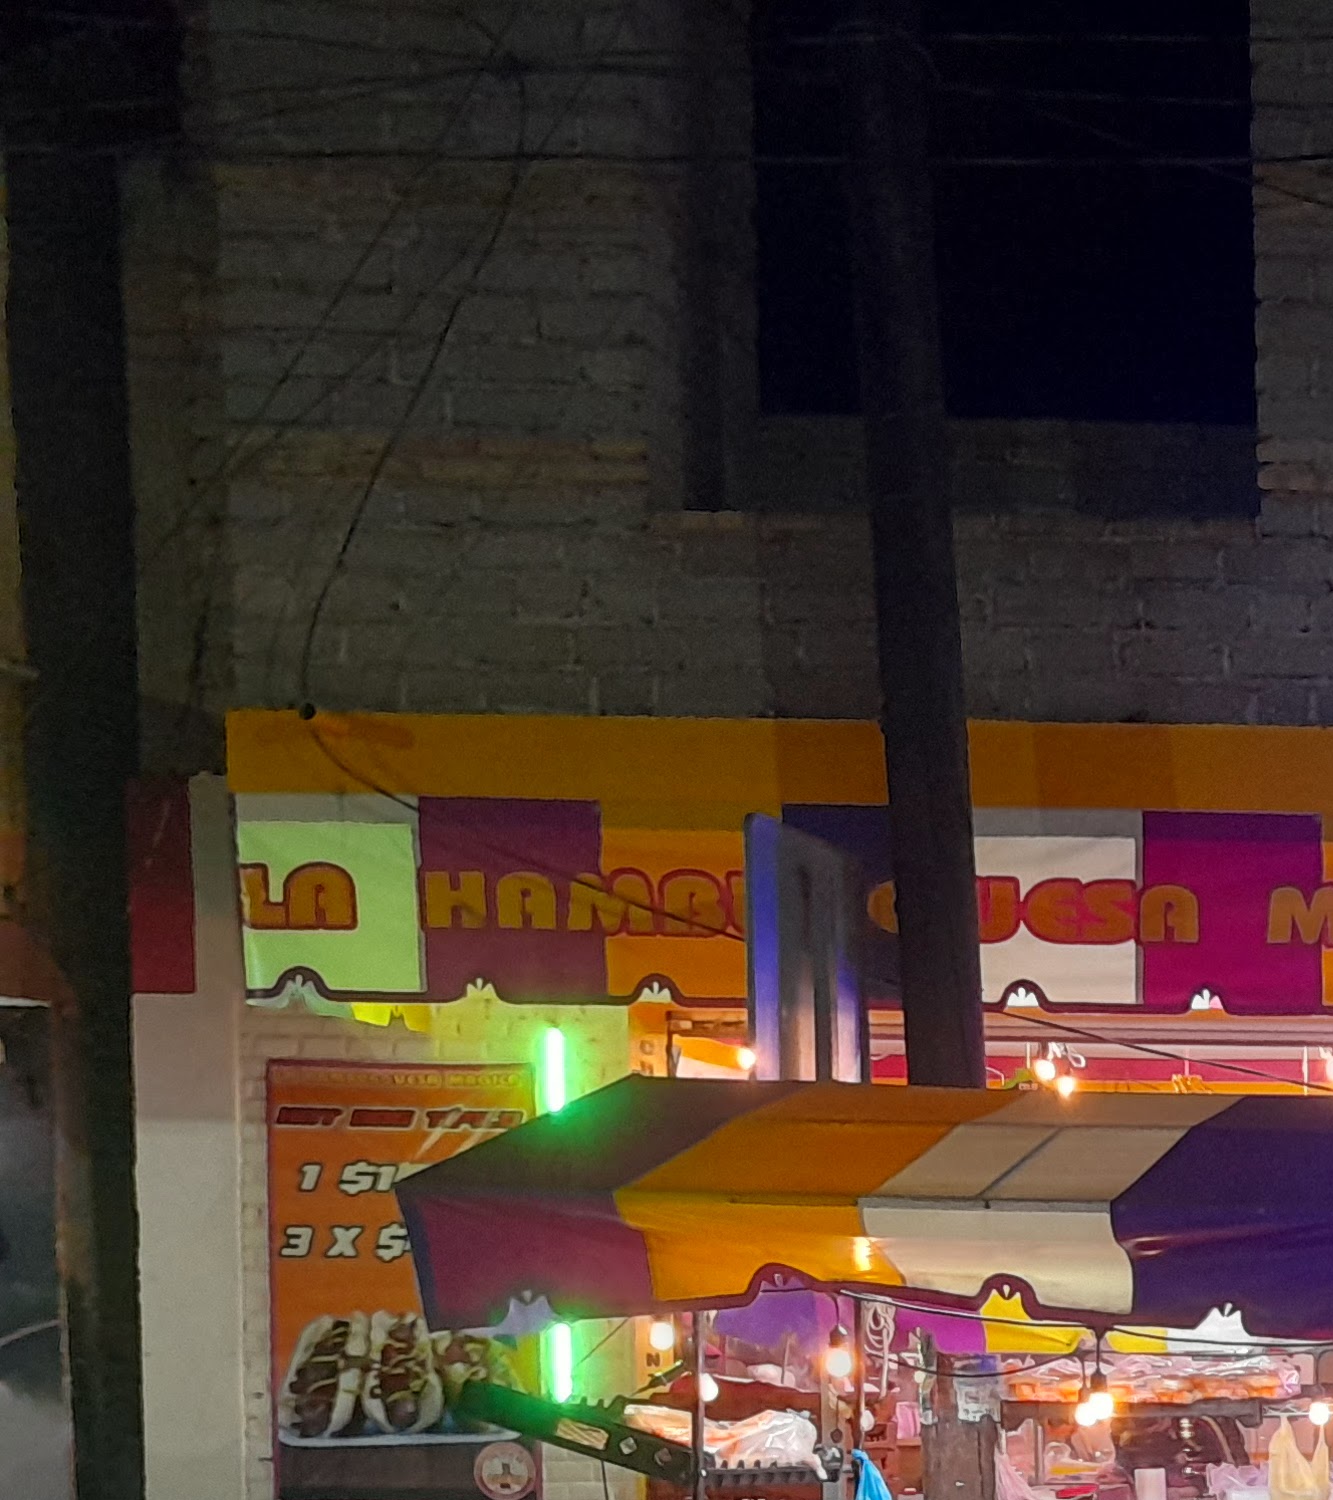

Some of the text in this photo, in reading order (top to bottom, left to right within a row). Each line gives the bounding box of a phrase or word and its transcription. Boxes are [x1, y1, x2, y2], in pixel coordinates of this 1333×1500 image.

[239, 862, 358, 930] LA
[418, 868, 1200, 945] HAMBUESA
[298, 1163, 322, 1193] 1
[279, 1224, 314, 1259] 3
